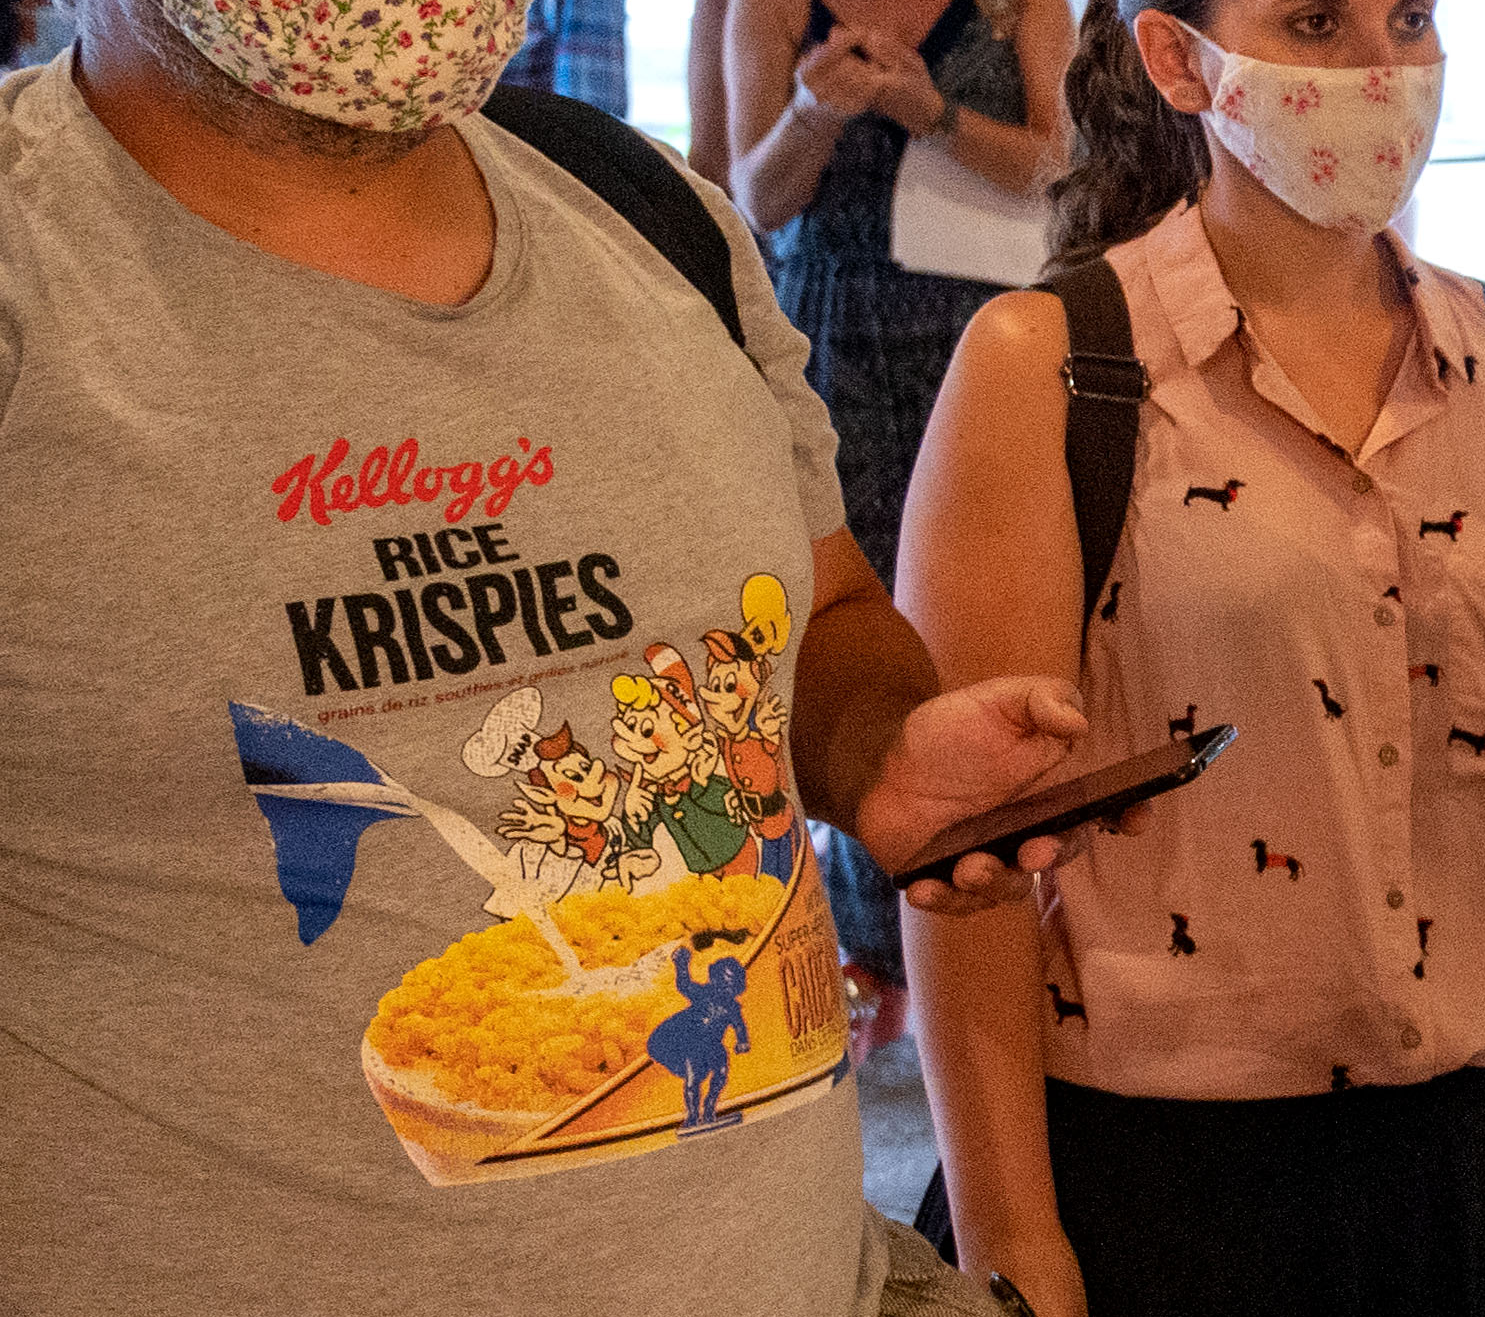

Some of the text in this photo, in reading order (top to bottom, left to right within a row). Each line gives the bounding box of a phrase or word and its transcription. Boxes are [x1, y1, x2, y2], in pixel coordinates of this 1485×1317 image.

[271, 437, 554, 526] Kellogg's
[372, 523, 520, 582] RICE
[285, 552, 634, 696] KRISPIES
